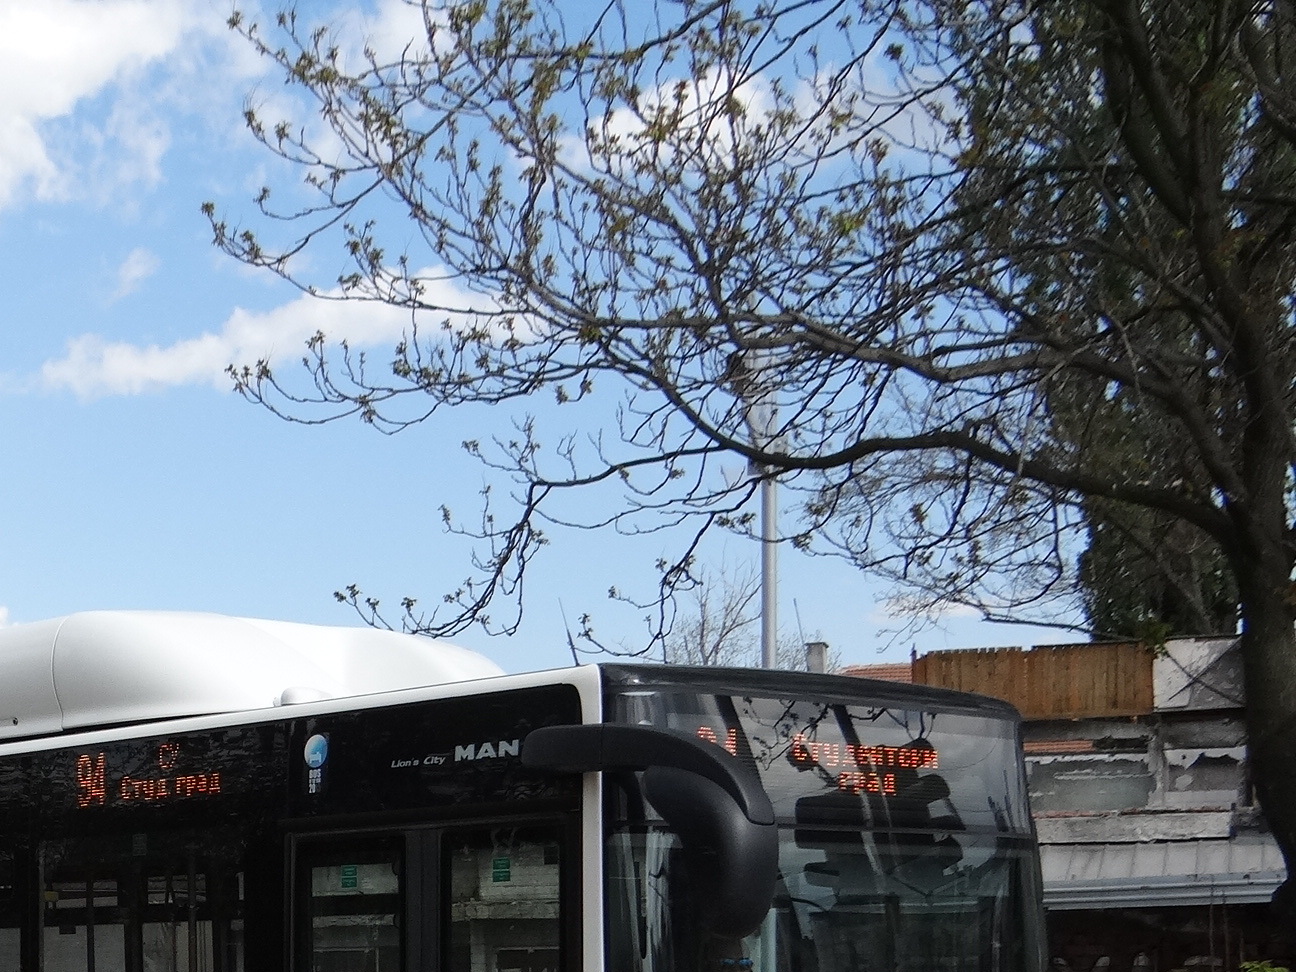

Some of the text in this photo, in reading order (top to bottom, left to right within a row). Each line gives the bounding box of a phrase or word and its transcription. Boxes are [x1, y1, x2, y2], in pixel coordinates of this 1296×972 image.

[391, 739, 519, 768] Lion's City MAN
[77, 752, 105, 807] 94
[838, 771, 897, 796] град
